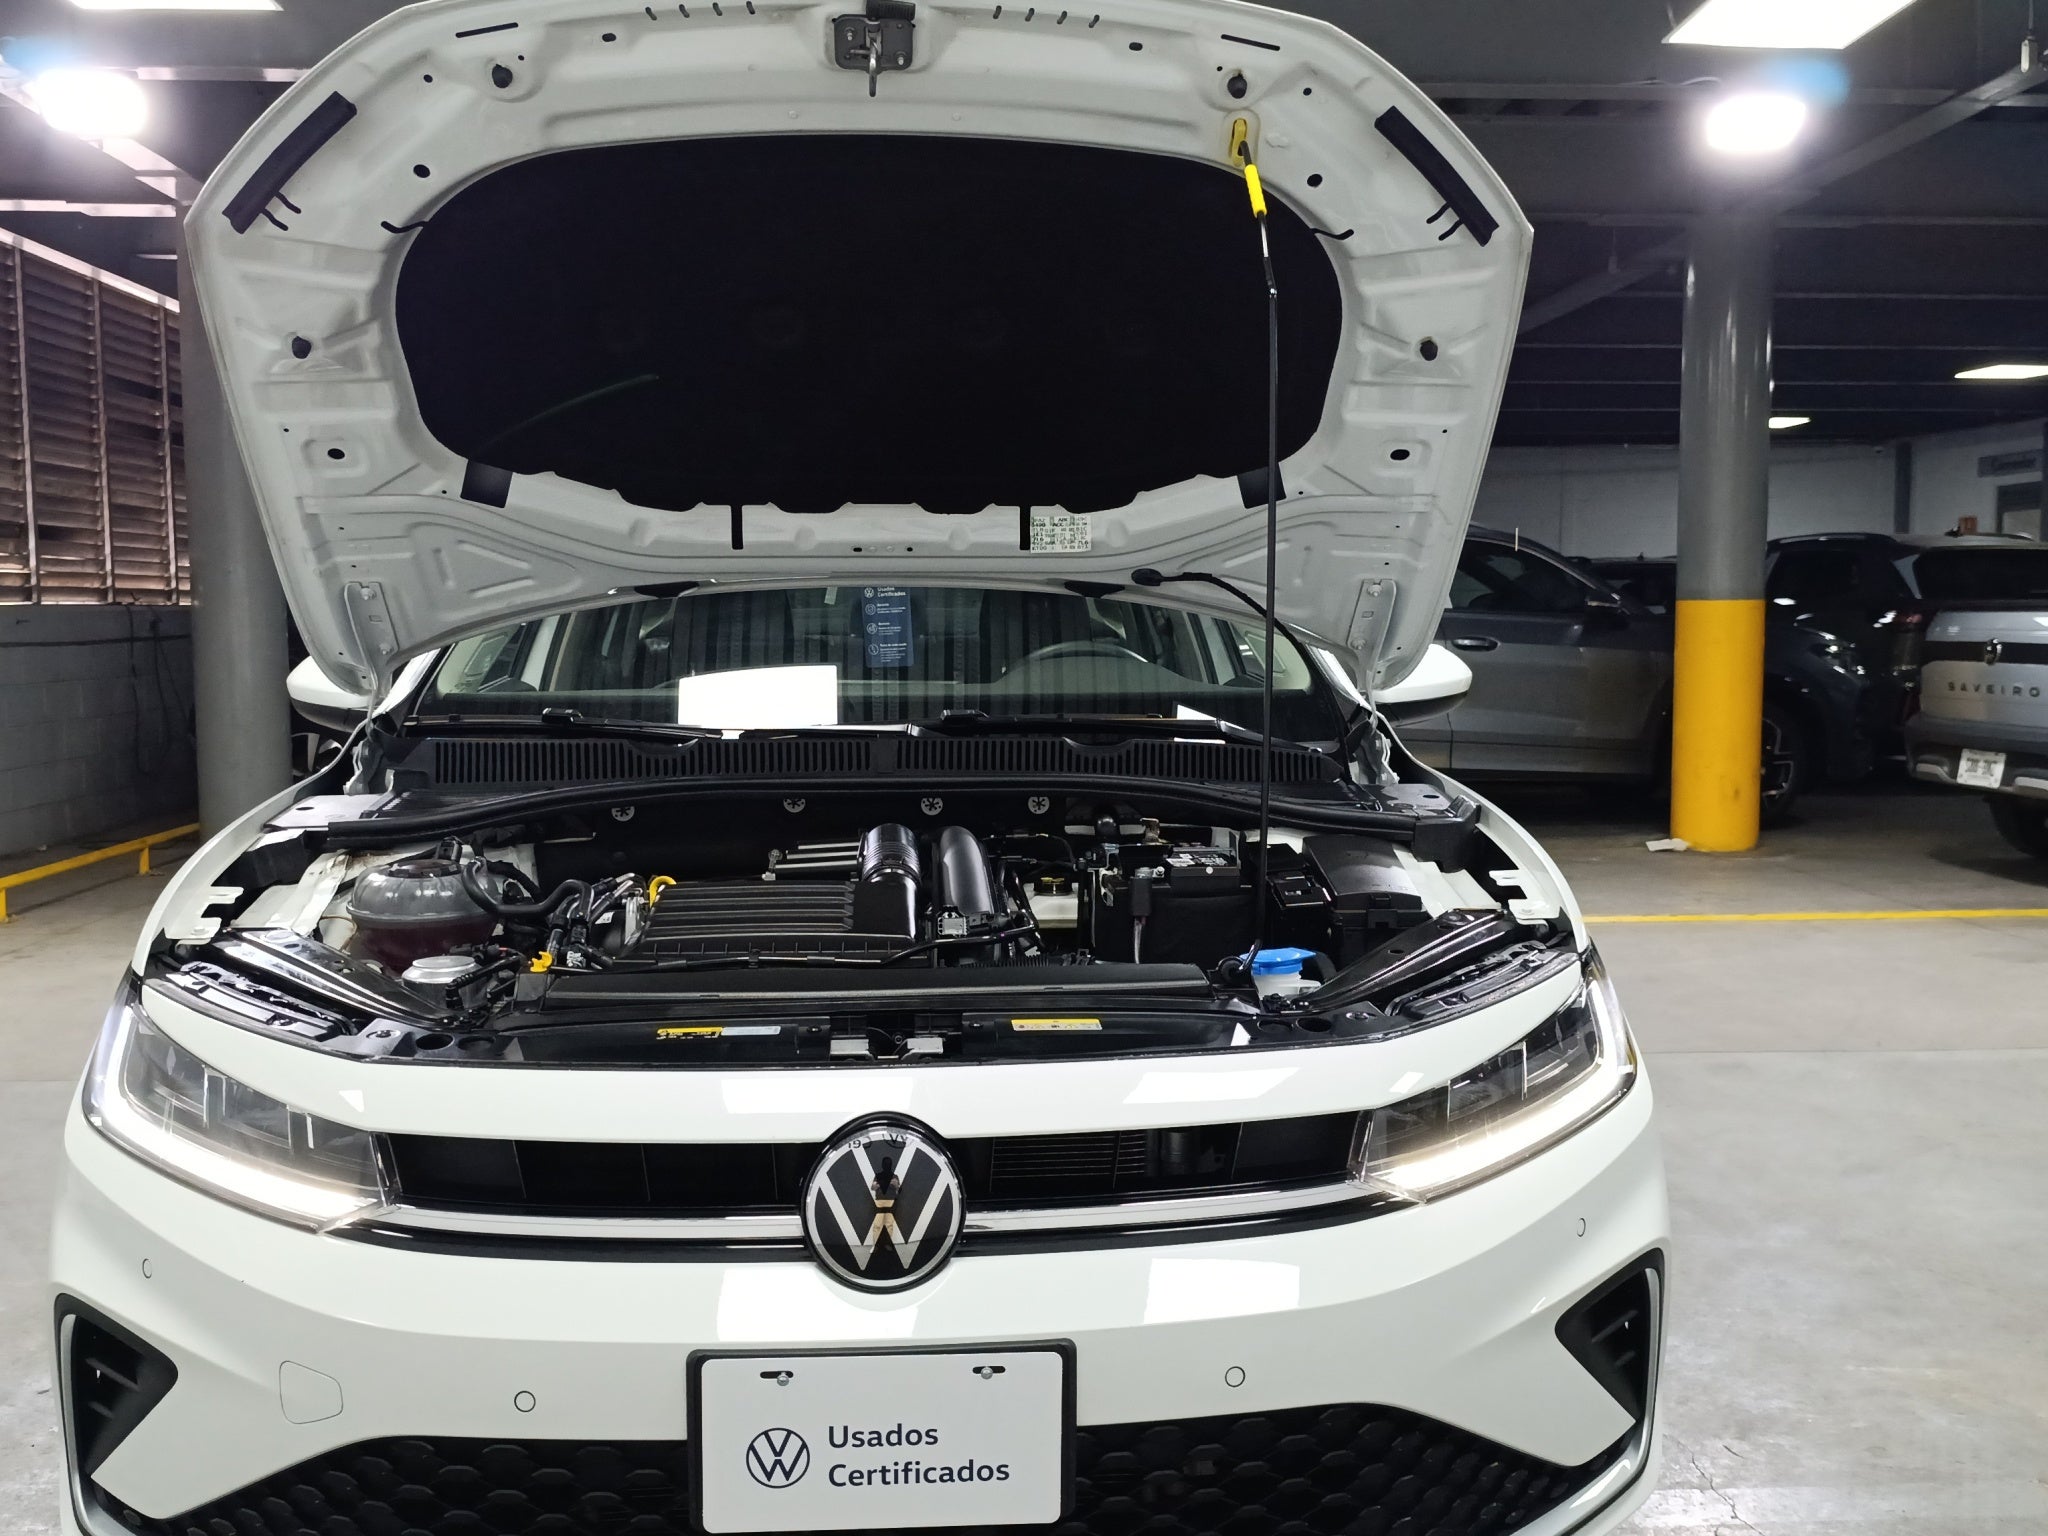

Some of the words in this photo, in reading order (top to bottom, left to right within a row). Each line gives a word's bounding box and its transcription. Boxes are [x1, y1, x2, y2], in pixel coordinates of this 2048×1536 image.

[1948, 682, 2040, 697] SAVEIRO
[828, 1423, 939, 1448] Usados
[828, 1459, 1010, 1488] Certificados
